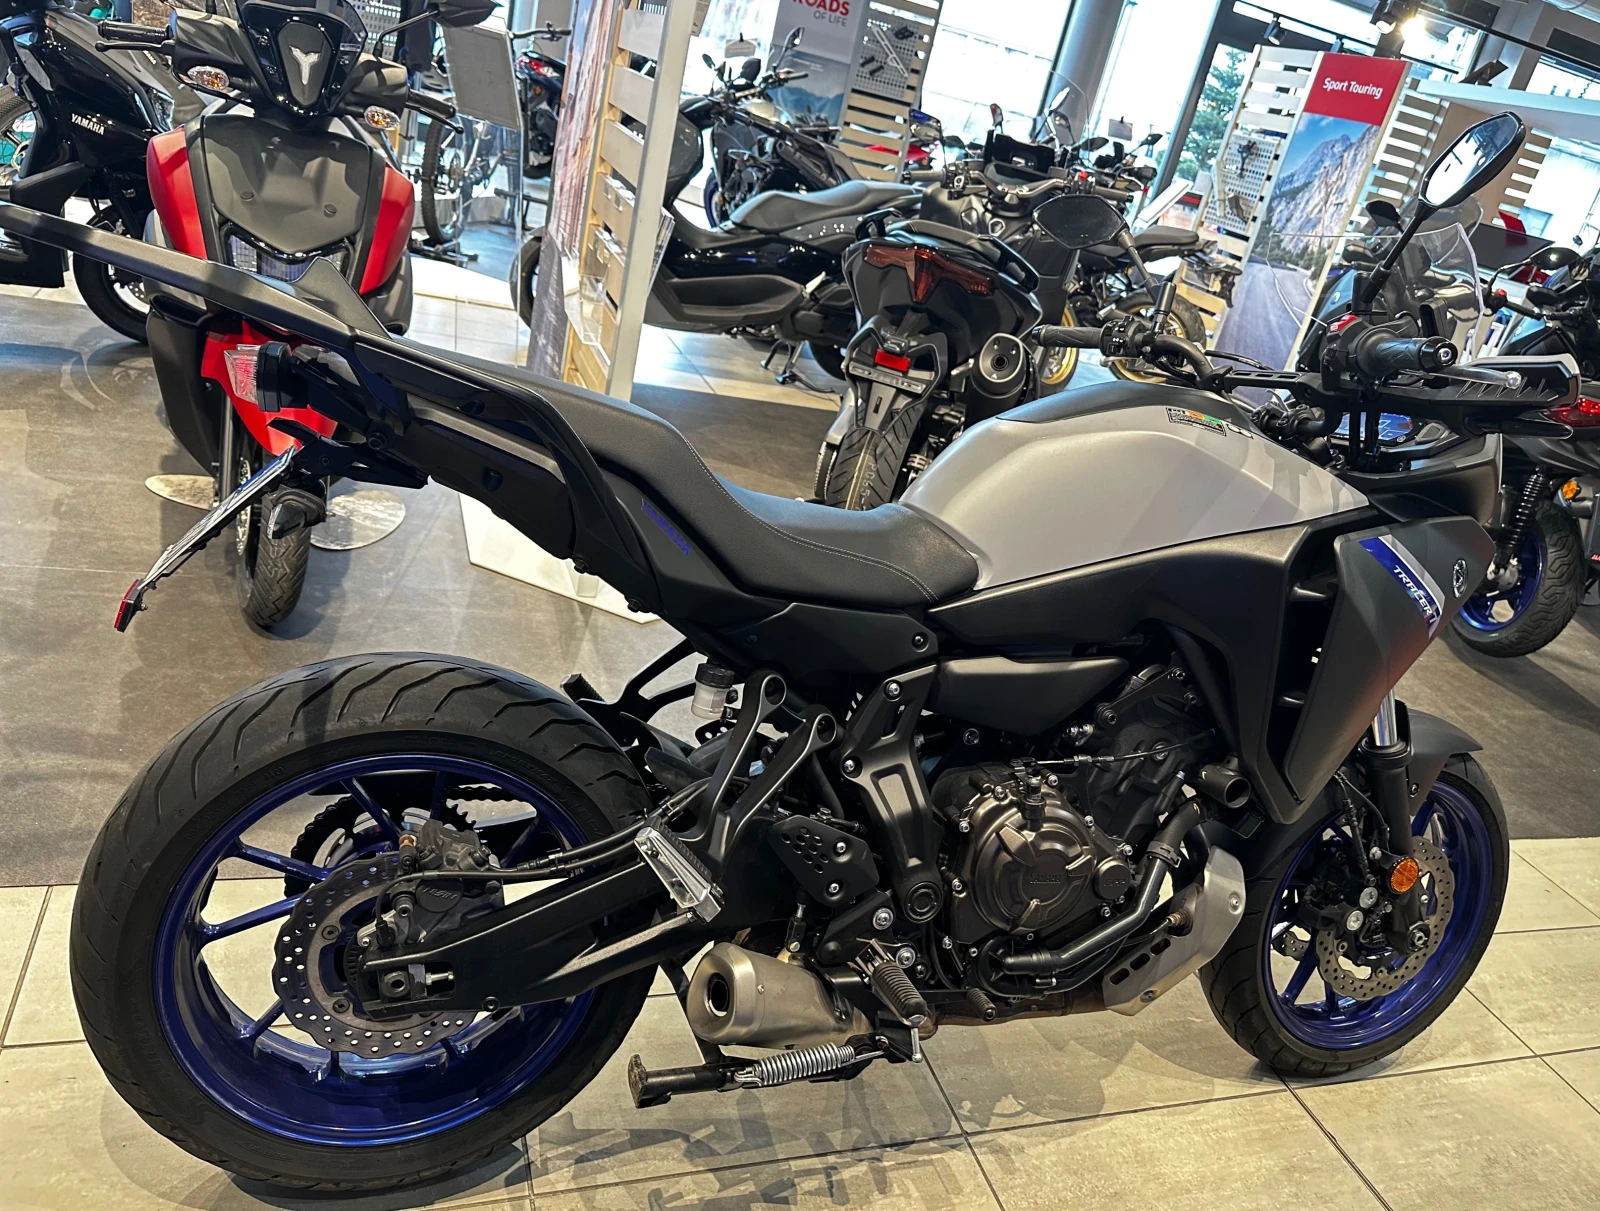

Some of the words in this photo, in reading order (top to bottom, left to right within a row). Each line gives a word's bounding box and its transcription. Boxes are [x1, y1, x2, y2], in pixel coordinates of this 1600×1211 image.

[792, 0, 850, 16] ADS
[813, 10, 827, 20] OF
[828, 14, 848, 27] LIFE
[1323, 78, 1348, 92] Sport
[1349, 81, 1383, 99] Touring
[71, 113, 105, 135] YAMAHA
[641, 498, 690, 556] YAMAHA
[1393, 565, 1432, 615] TRACER
